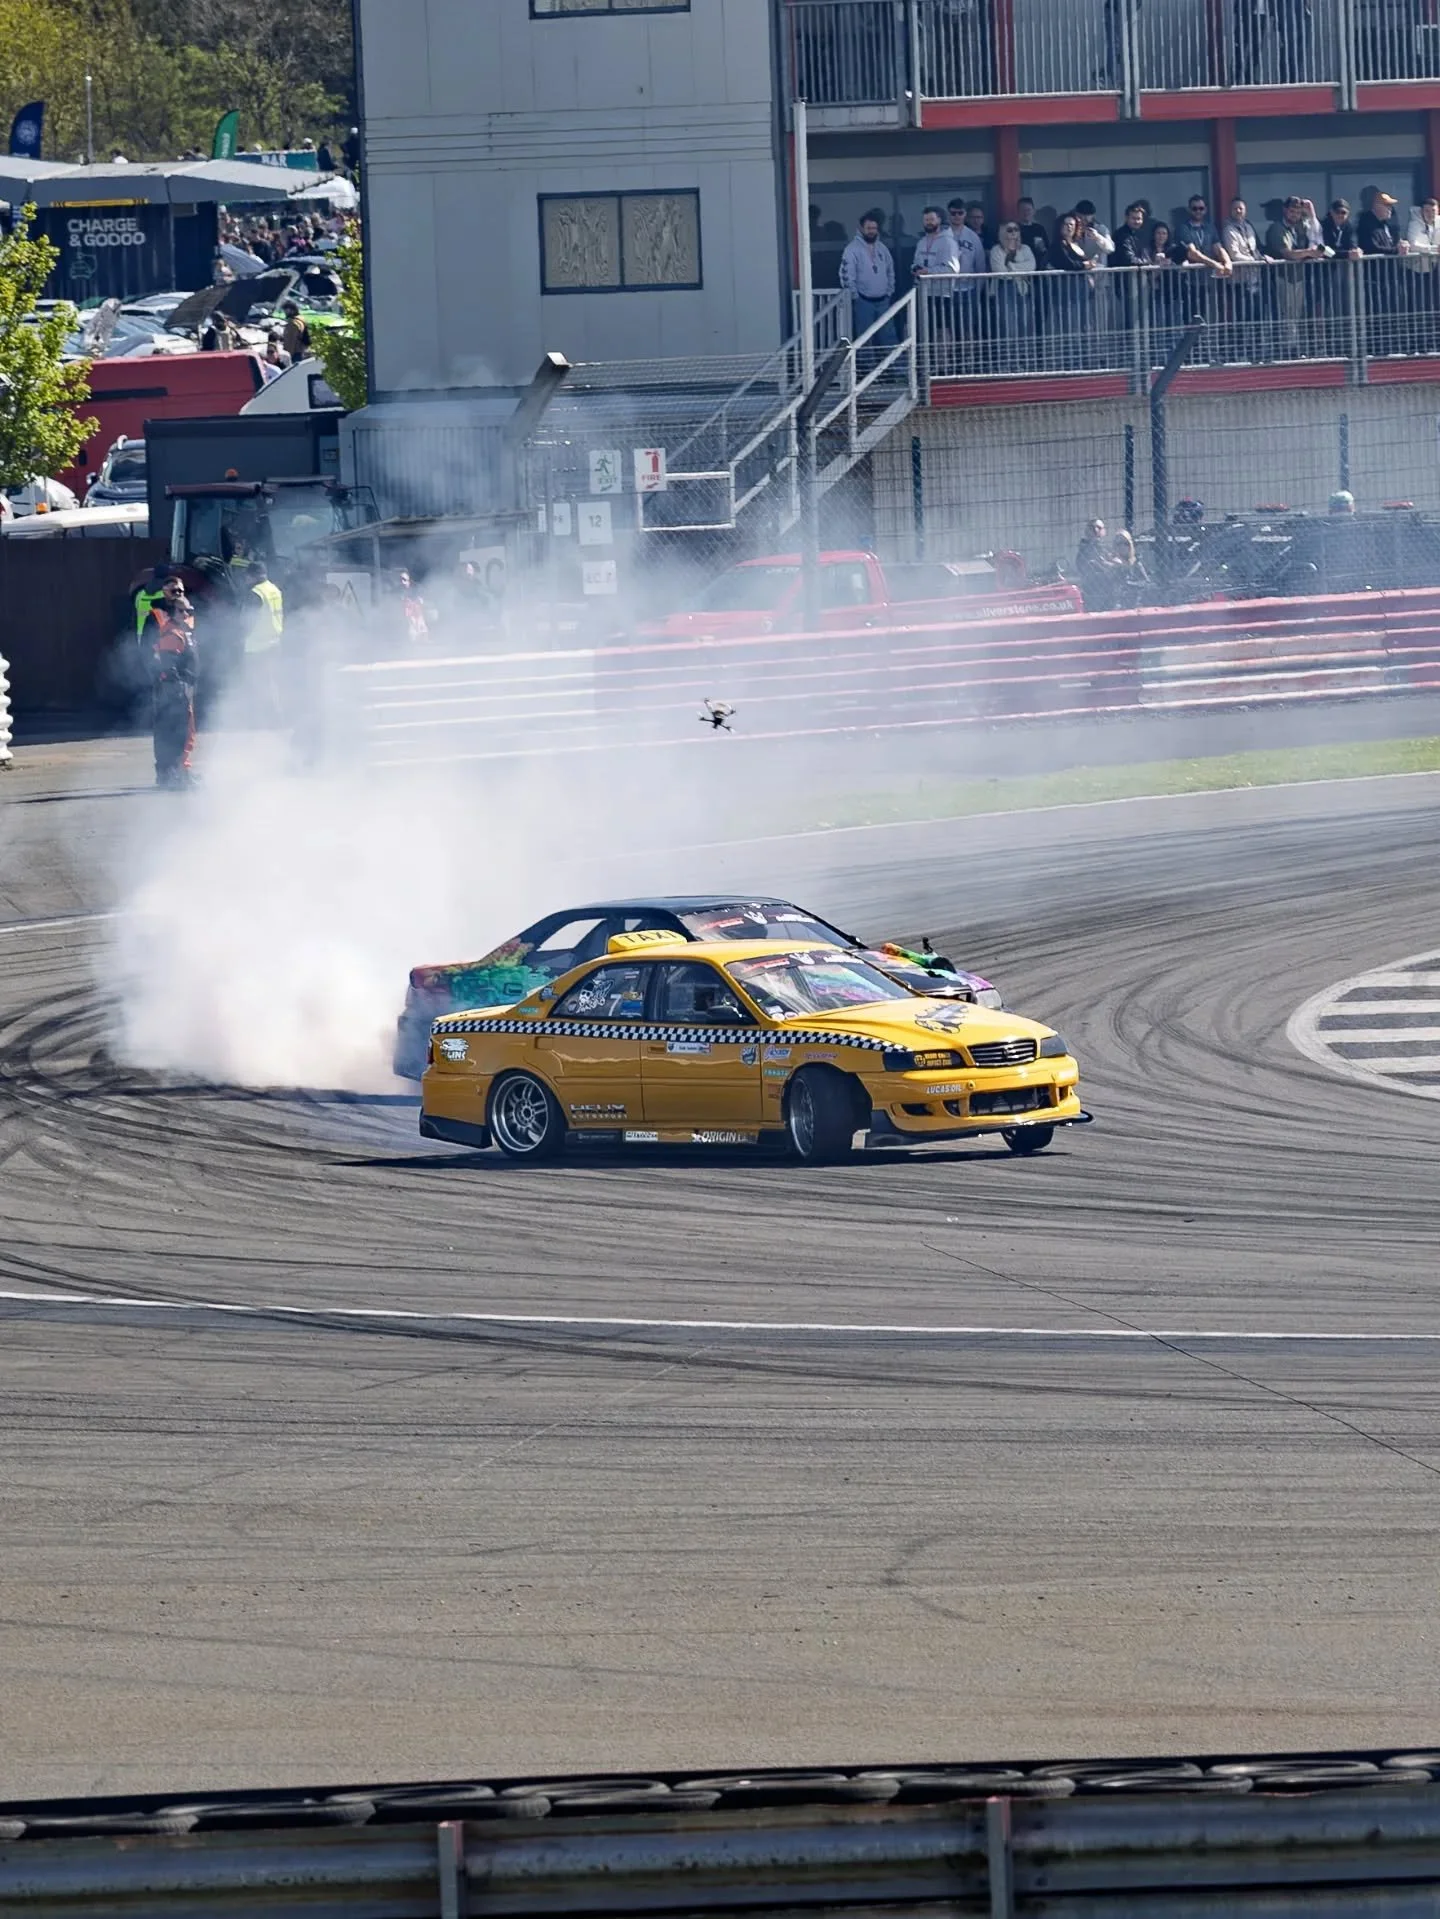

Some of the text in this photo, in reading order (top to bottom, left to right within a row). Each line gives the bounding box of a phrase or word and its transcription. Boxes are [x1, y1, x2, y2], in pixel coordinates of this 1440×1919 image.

[67, 218, 138, 232] CHARGE
[69, 234, 81, 247] &
[588, 515, 602, 528] 12
[619, 930, 677, 943] TAXI
[608, 993, 622, 1017] 7
[926, 1084, 962, 1095] LUCAS OIL
[702, 1131, 737, 1144] ORIGIN
